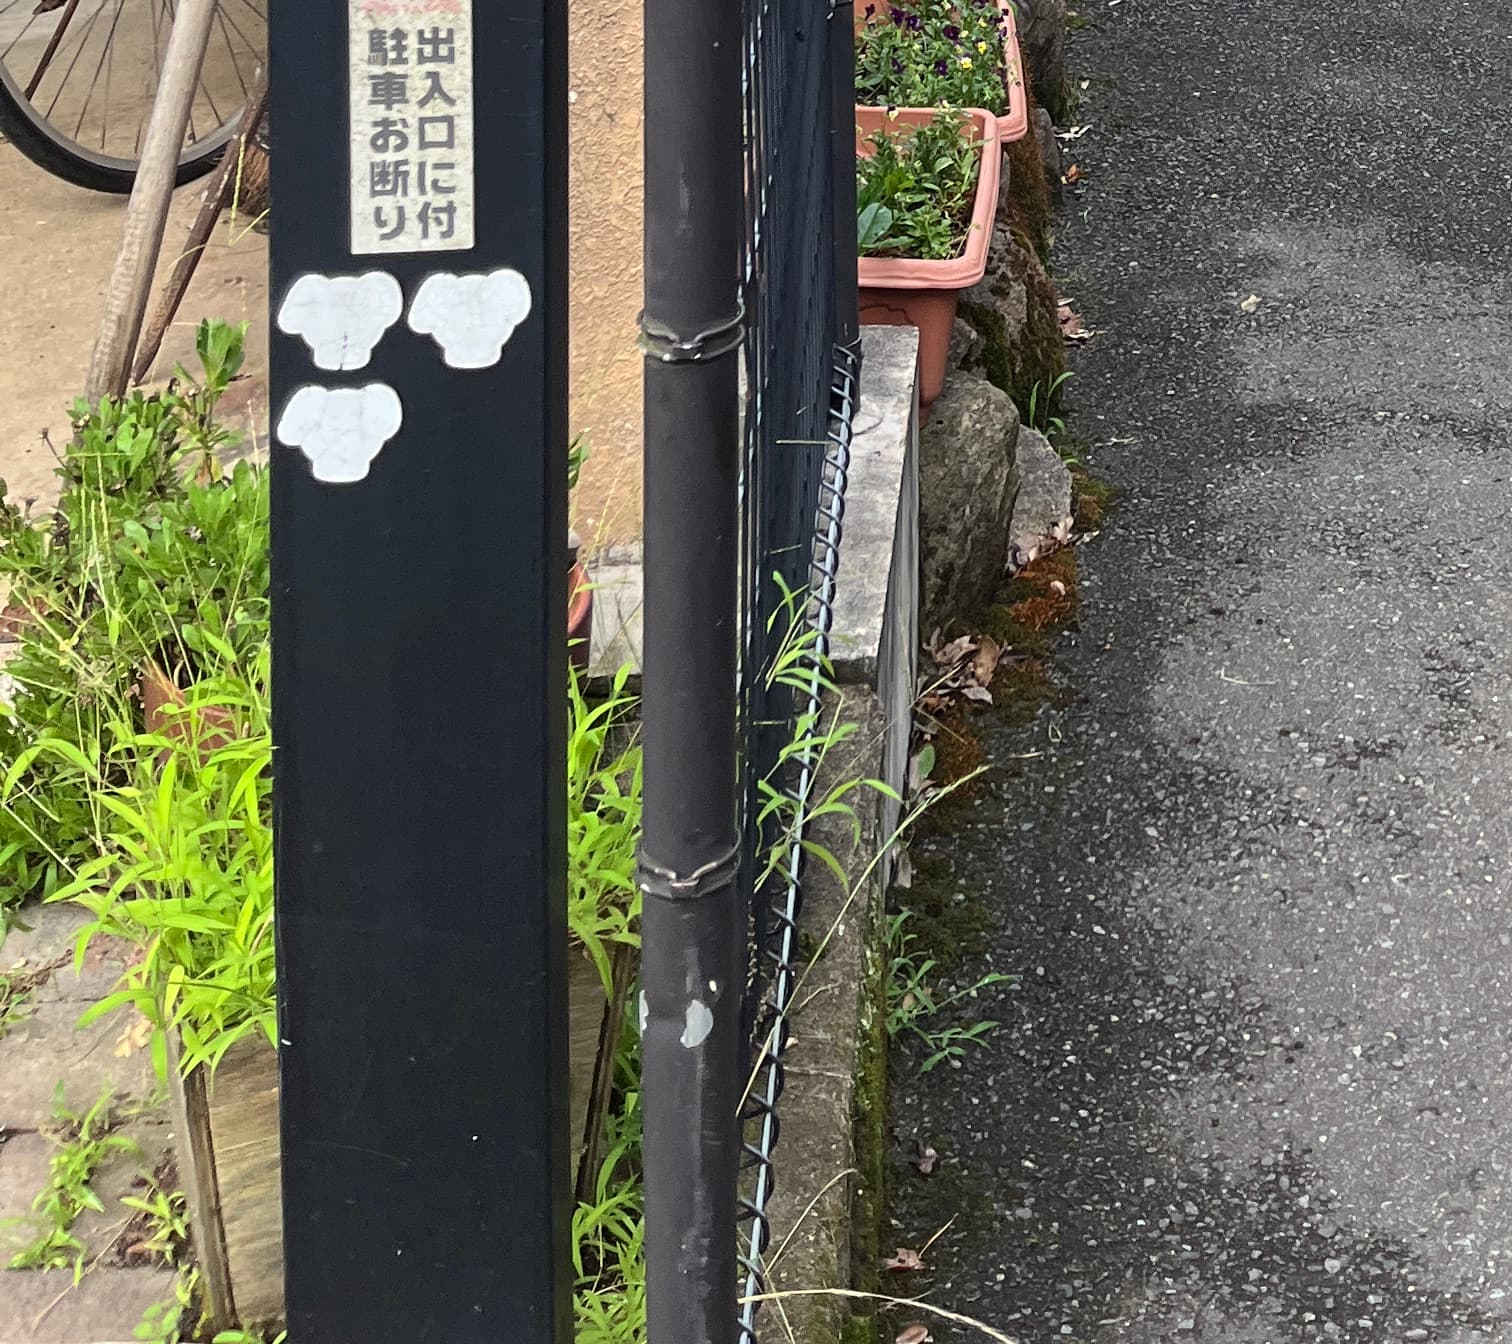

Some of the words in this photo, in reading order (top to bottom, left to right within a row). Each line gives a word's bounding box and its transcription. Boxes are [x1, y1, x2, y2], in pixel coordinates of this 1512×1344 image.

[367, 27, 409, 241] 駐車お断り
[416, 26, 457, 240] 出入口に付
